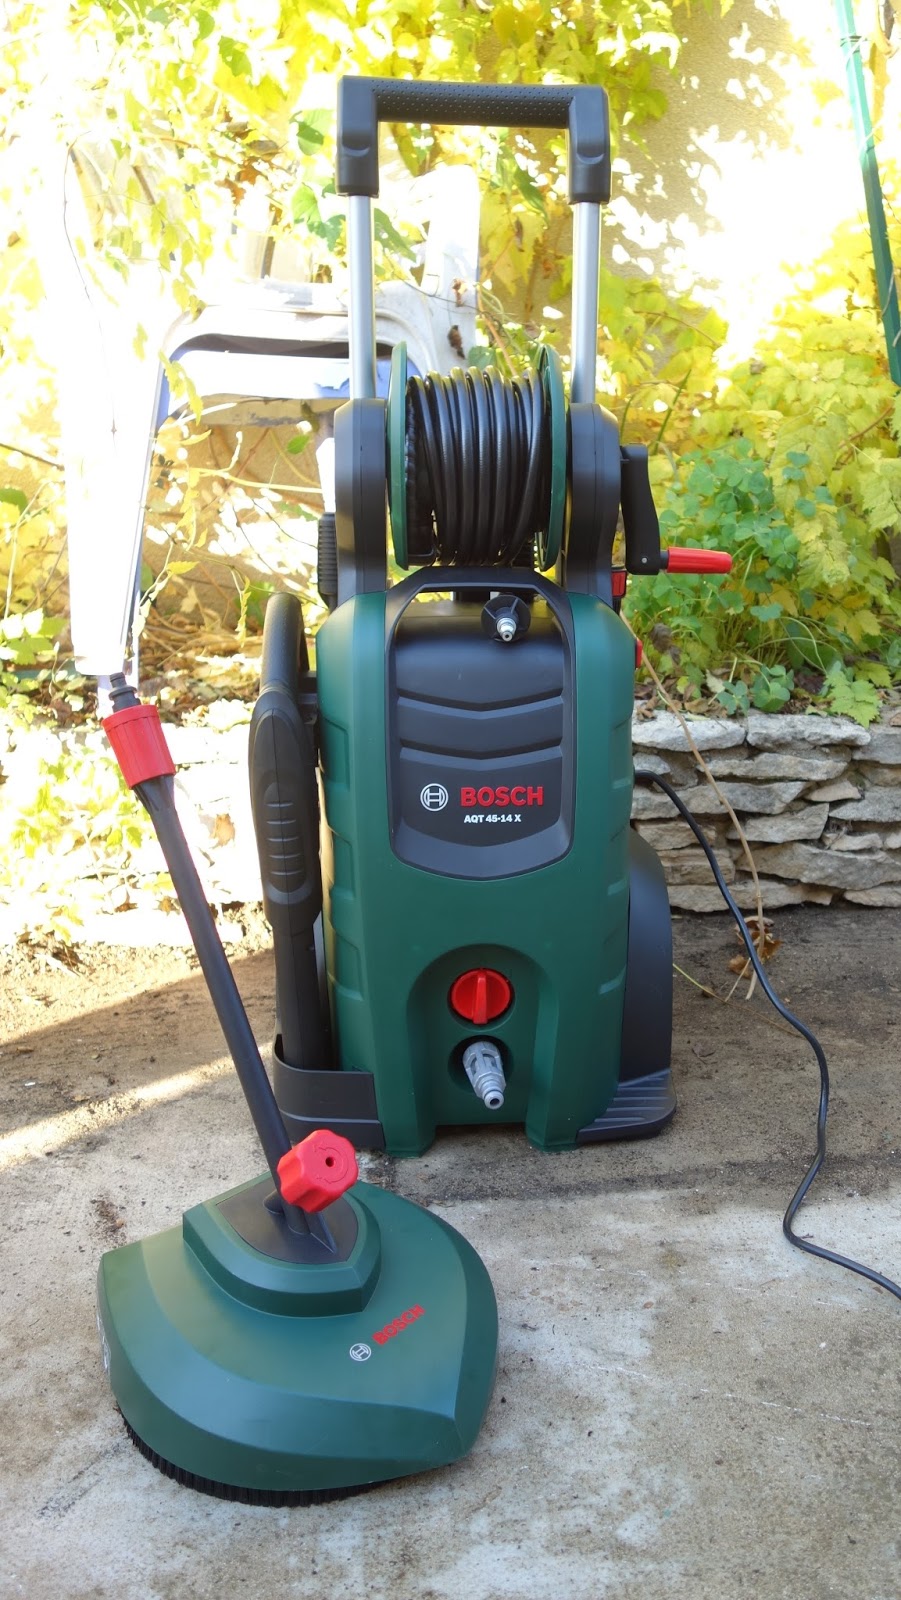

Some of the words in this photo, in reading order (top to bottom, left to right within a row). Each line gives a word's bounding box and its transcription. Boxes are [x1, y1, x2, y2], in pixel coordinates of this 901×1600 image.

[460, 786, 544, 807] BOSCH
[463, 814, 485, 823] AQT
[514, 814, 522, 822] X
[372, 1303, 425, 1346] BOSCH
